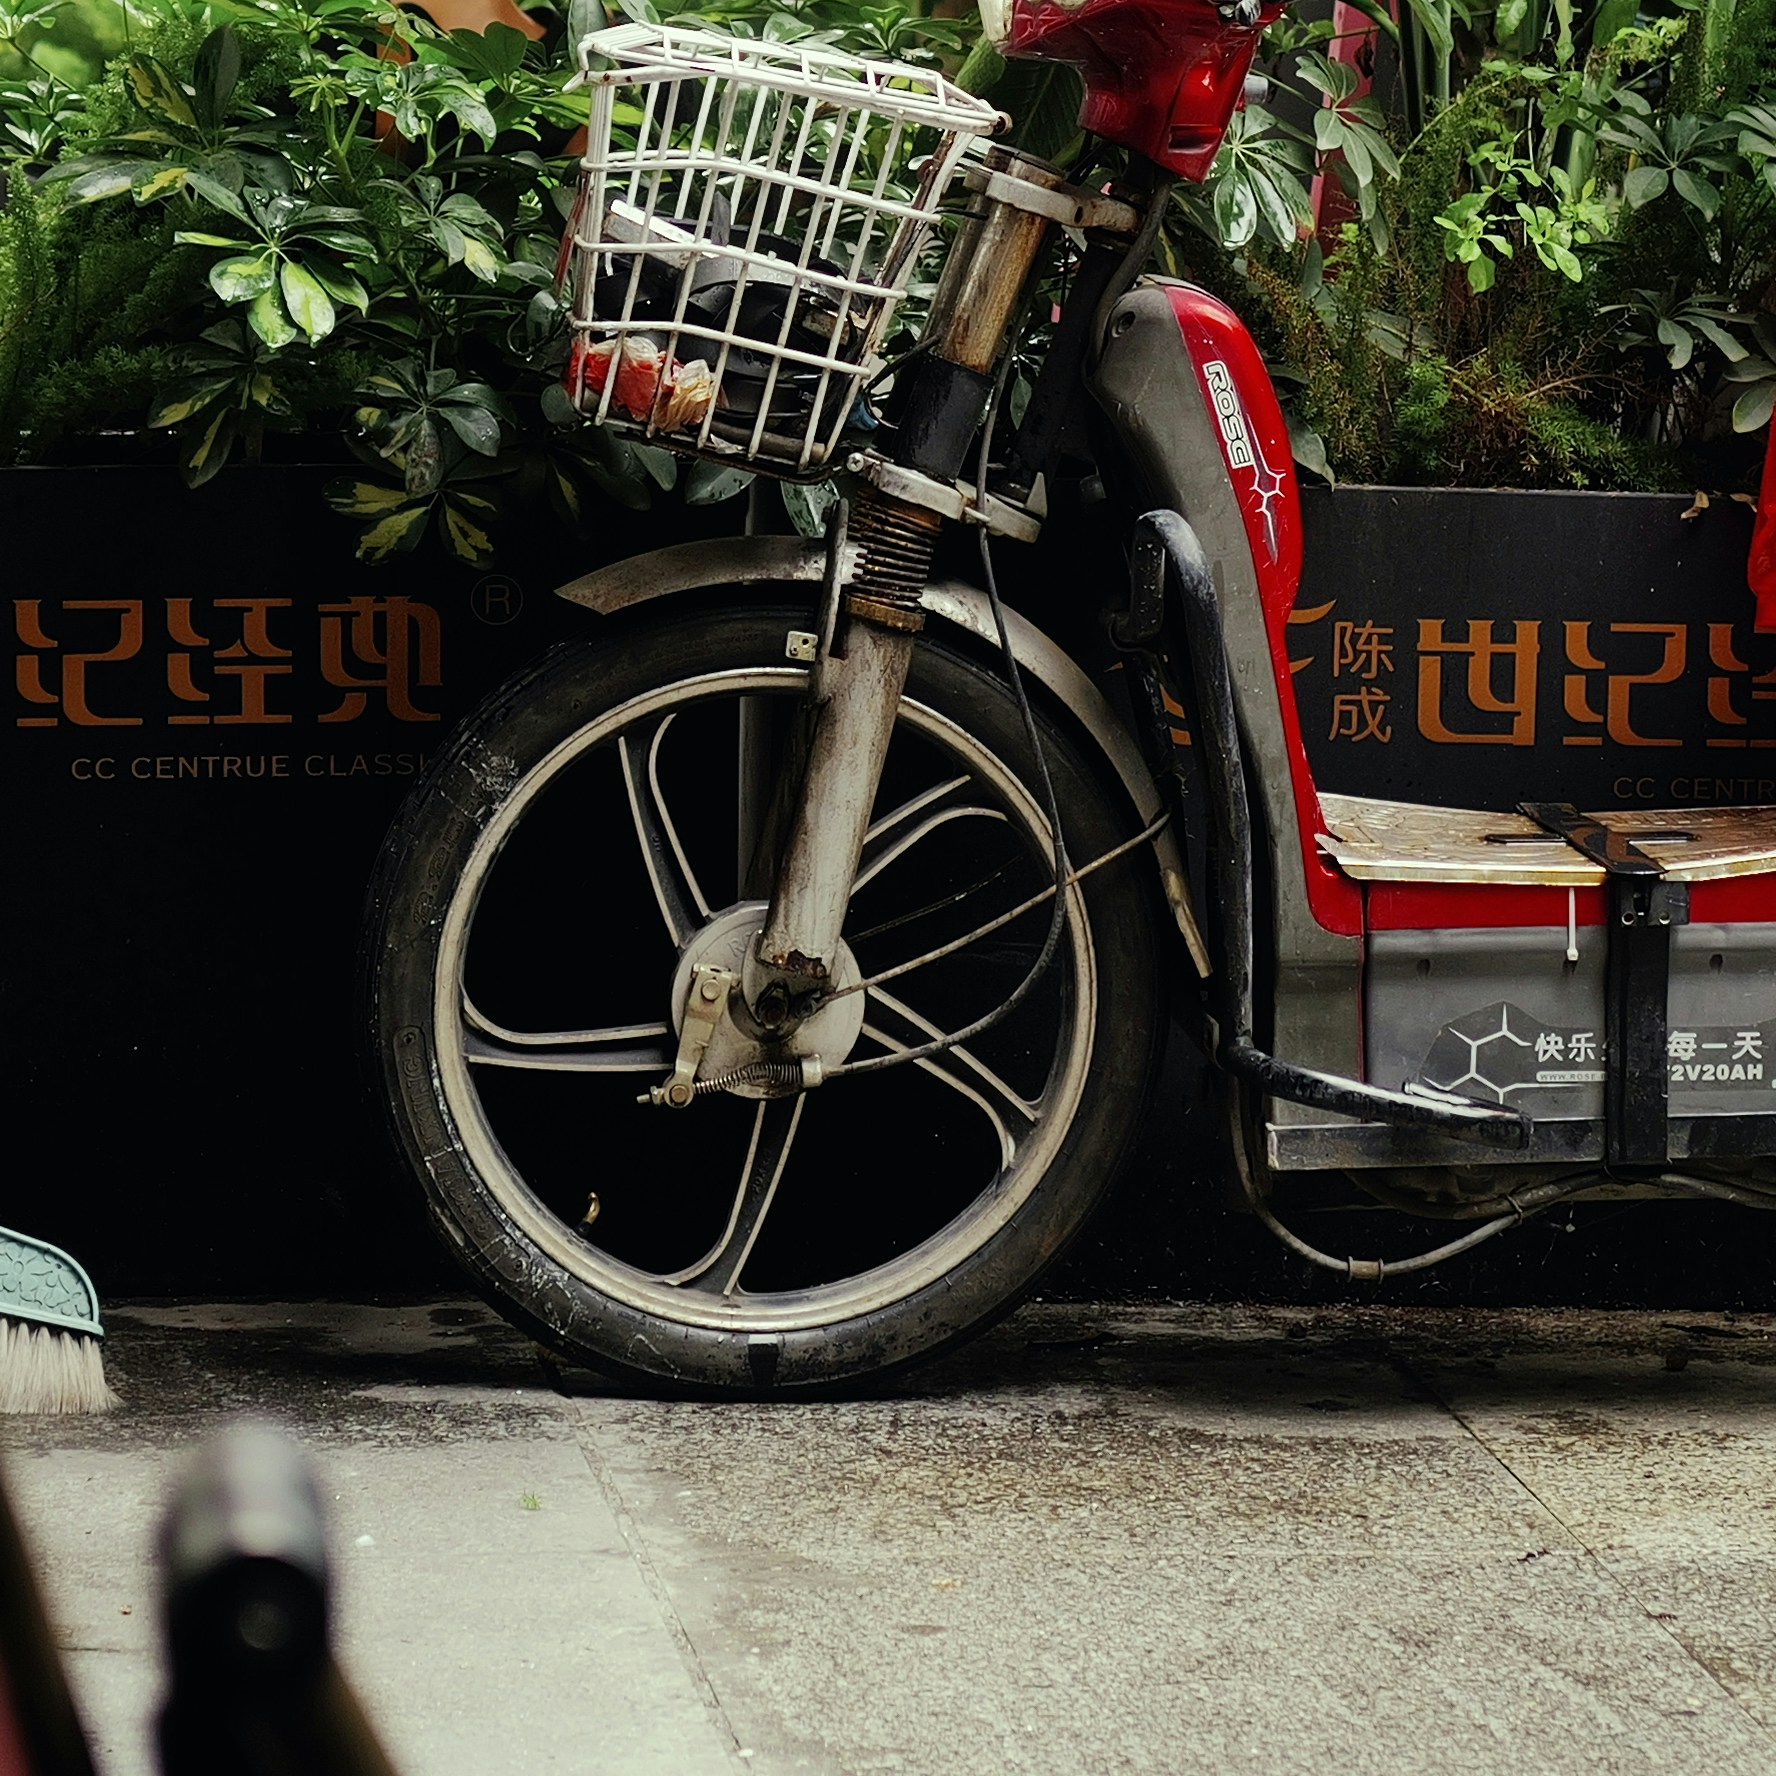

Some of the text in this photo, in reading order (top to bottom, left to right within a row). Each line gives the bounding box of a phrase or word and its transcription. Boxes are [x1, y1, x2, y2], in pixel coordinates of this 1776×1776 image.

[1203, 361, 1254, 468] ROSE
[1328, 619, 1395, 743] 陈成
[71, 751, 429, 781] CC CENTRUE CLASSI
[1612, 775, 1656, 801] CC
[1667, 1063, 1764, 1082] 2V20AH
